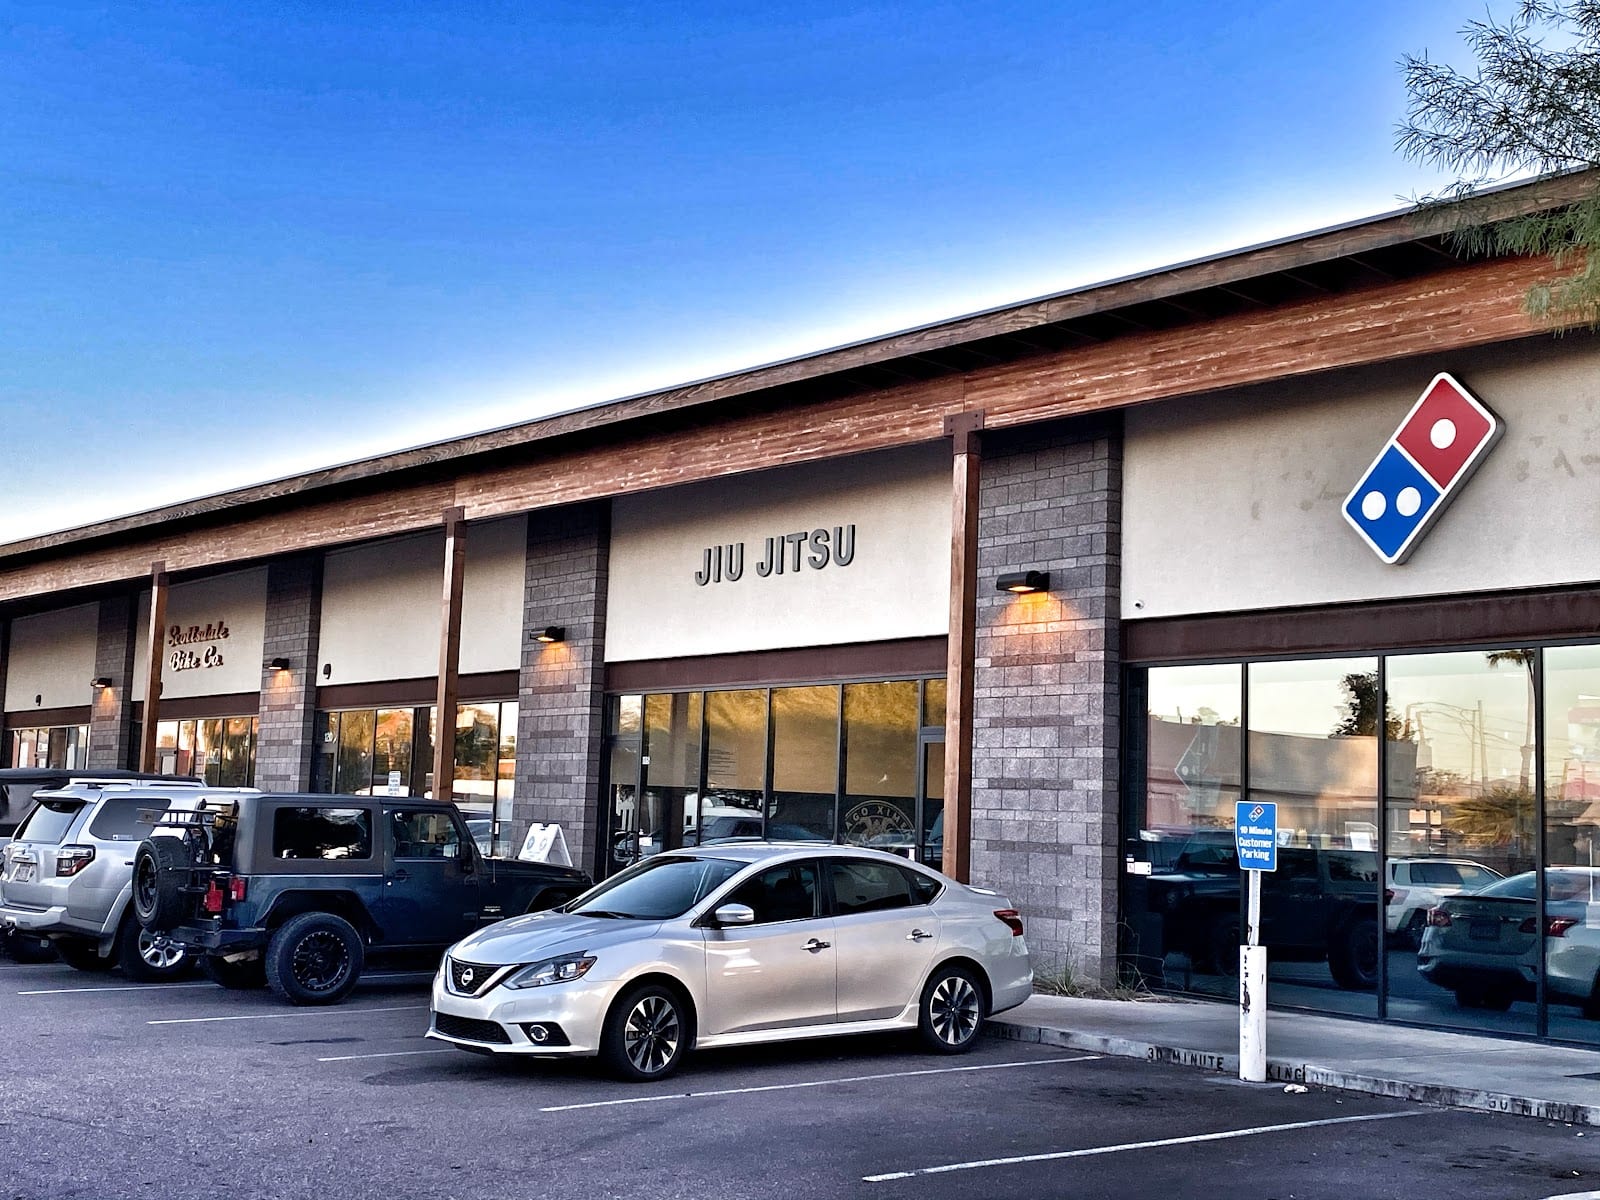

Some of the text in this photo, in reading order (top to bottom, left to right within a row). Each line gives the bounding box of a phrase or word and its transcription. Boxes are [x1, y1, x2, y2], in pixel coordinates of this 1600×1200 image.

[694, 524, 856, 586] JIU JITSU
[168, 621, 230, 647] Scottsdale
[169, 649, 201, 672] Bike
[845, 806, 908, 830] AGO XIME
[1249, 825, 1273, 836] Minute
[1238, 836, 1274, 849] Customer
[1241, 848, 1271, 862] Parking
[1147, 1047, 1163, 1060] 30
[1172, 1049, 1225, 1072] MINUTE
[1266, 1063, 1302, 1080] KING
